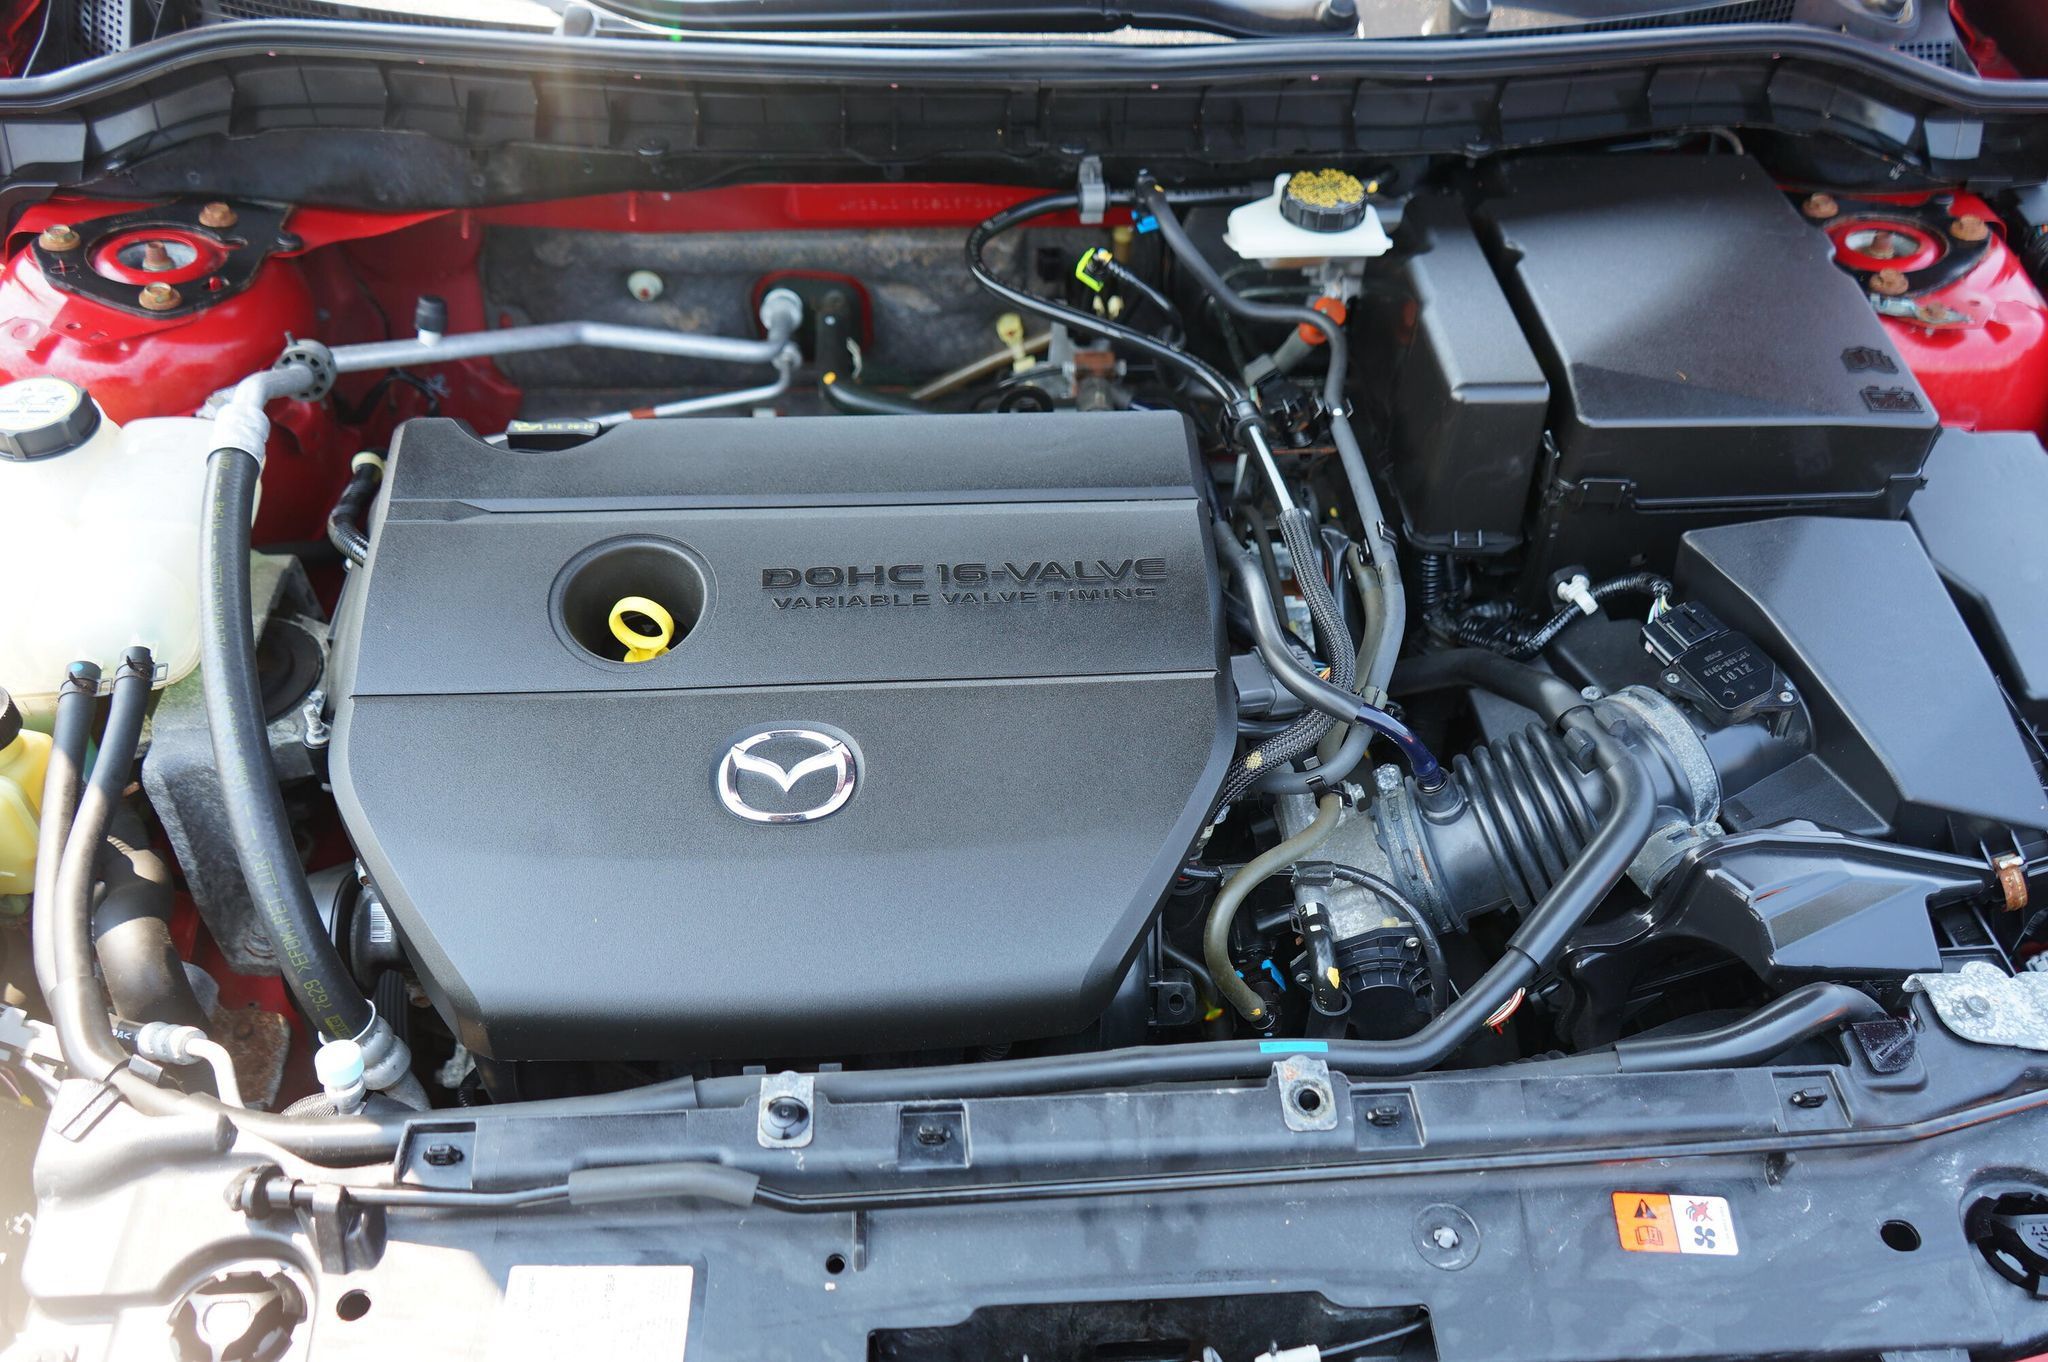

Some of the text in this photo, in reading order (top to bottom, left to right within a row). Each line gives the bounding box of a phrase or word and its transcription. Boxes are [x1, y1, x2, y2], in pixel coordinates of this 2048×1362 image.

[762, 557, 1168, 589] DOHC 16-VALVE
[772, 588, 1157, 610] VARIABLE VALVE TIMING
[304, 979, 333, 1012] 7629
